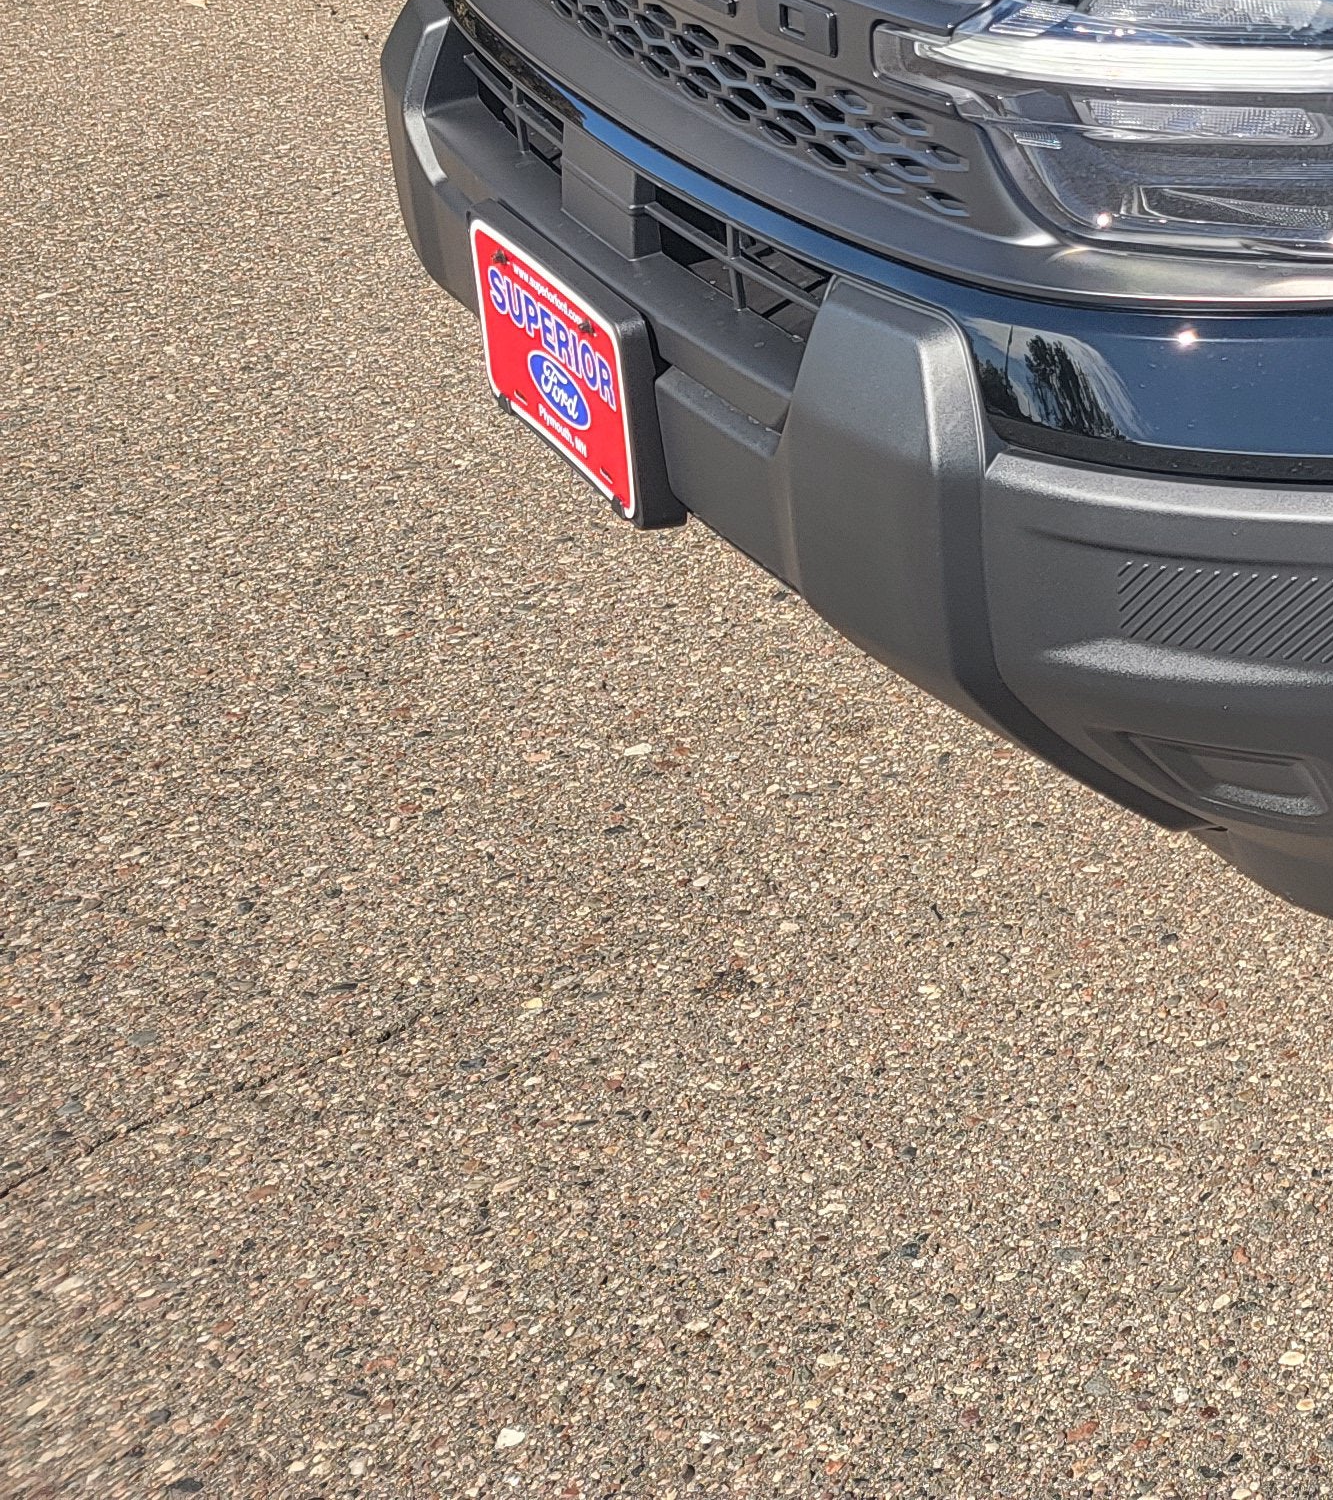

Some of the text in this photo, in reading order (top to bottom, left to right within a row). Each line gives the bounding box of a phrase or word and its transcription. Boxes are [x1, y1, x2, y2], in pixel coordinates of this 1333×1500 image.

[487, 265, 617, 412] SUPERIOR
[539, 358, 580, 422] Ford
[537, 402, 588, 458] Plymouth, MN
